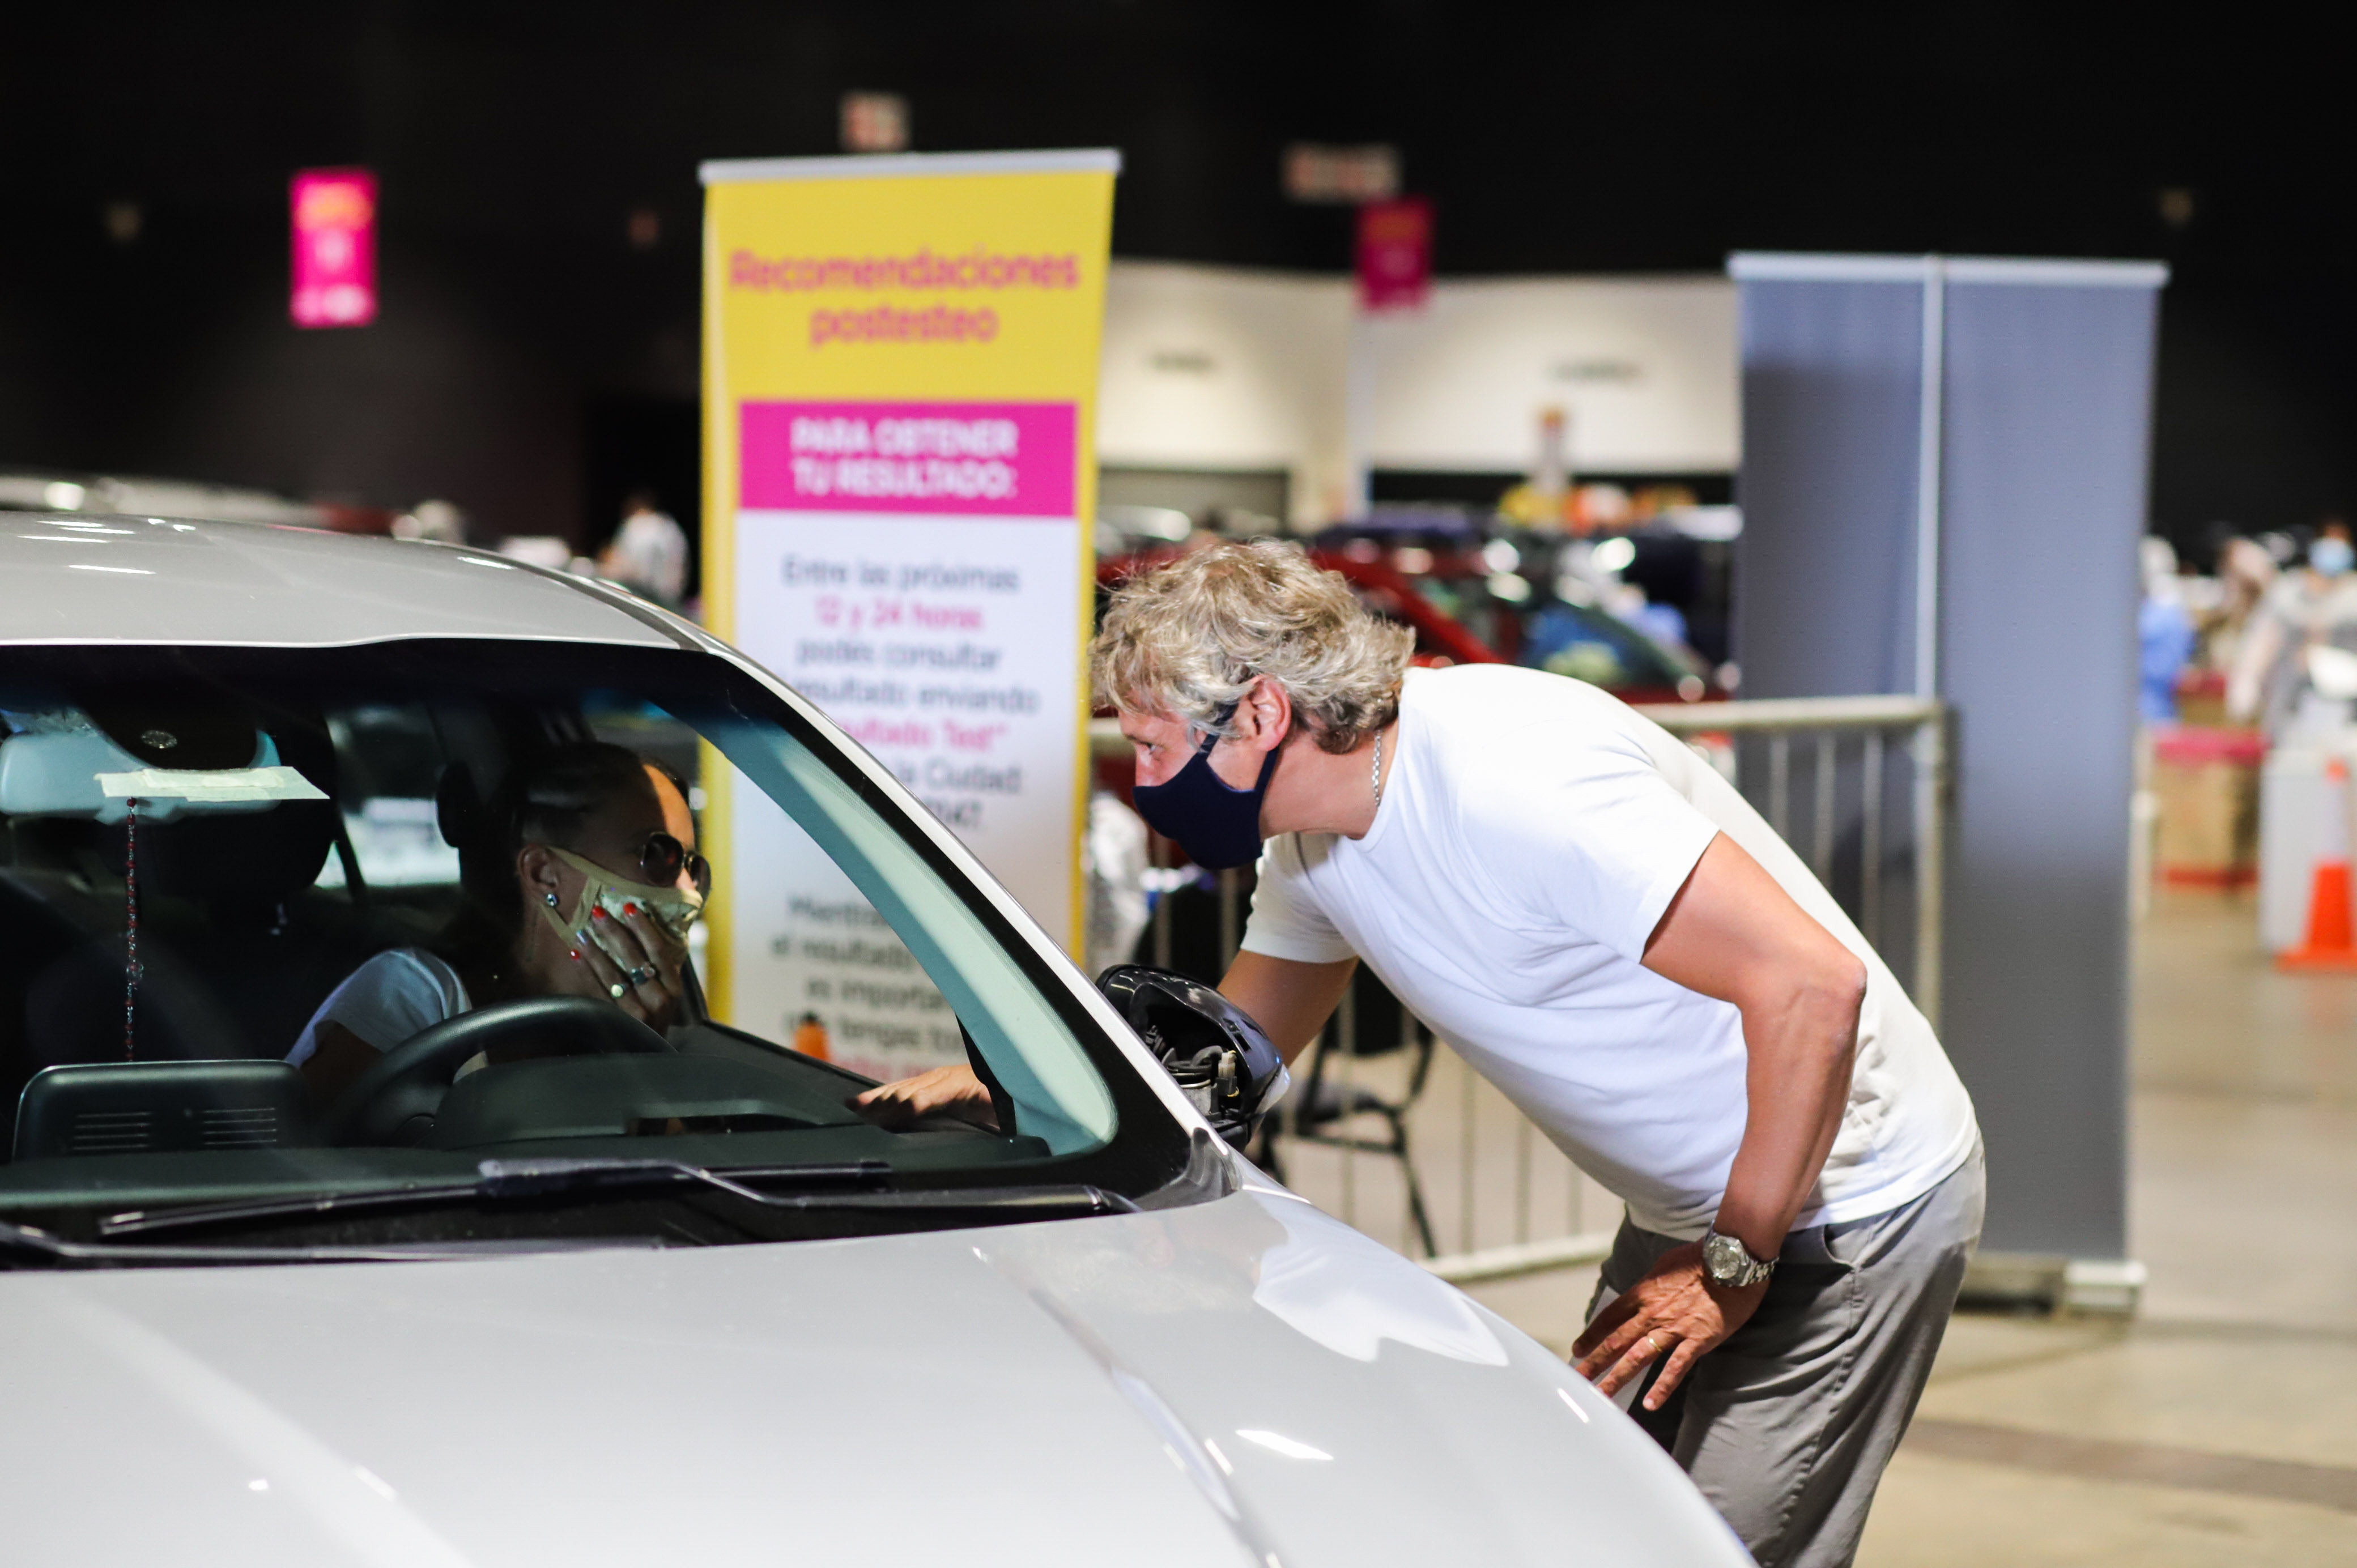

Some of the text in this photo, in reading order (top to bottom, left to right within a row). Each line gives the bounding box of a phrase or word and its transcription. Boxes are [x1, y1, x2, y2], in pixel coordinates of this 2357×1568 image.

[731, 245, 1078, 289] Recomendaciones
[810, 305, 997, 347] postesteo
[791, 417, 1018, 456] PARA OBTENER
[792, 457, 832, 495] TU
[783, 553, 848, 586] Entre
